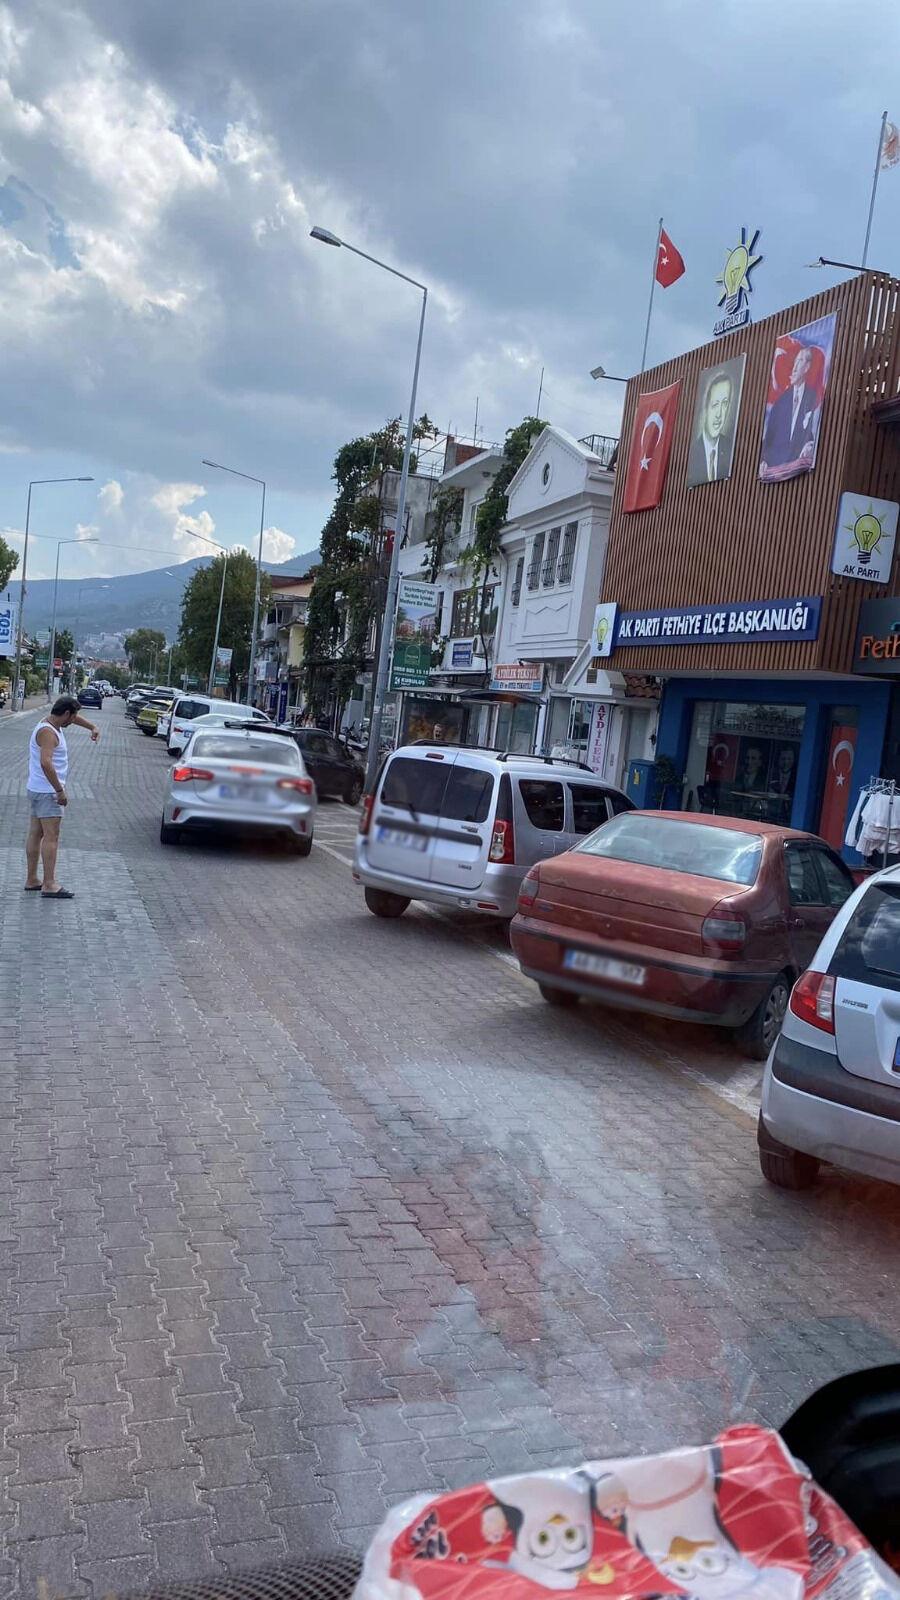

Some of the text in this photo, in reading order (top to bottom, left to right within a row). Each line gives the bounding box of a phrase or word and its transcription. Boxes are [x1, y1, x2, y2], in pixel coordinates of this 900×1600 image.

[842, 564, 855, 575] AK
[618, 619, 633, 637] AK
[661, 614, 702, 636] FETHİYE
[702, 613, 726, 635] İLÇE
[727, 601, 809, 635] BAŞKANLIĞI
